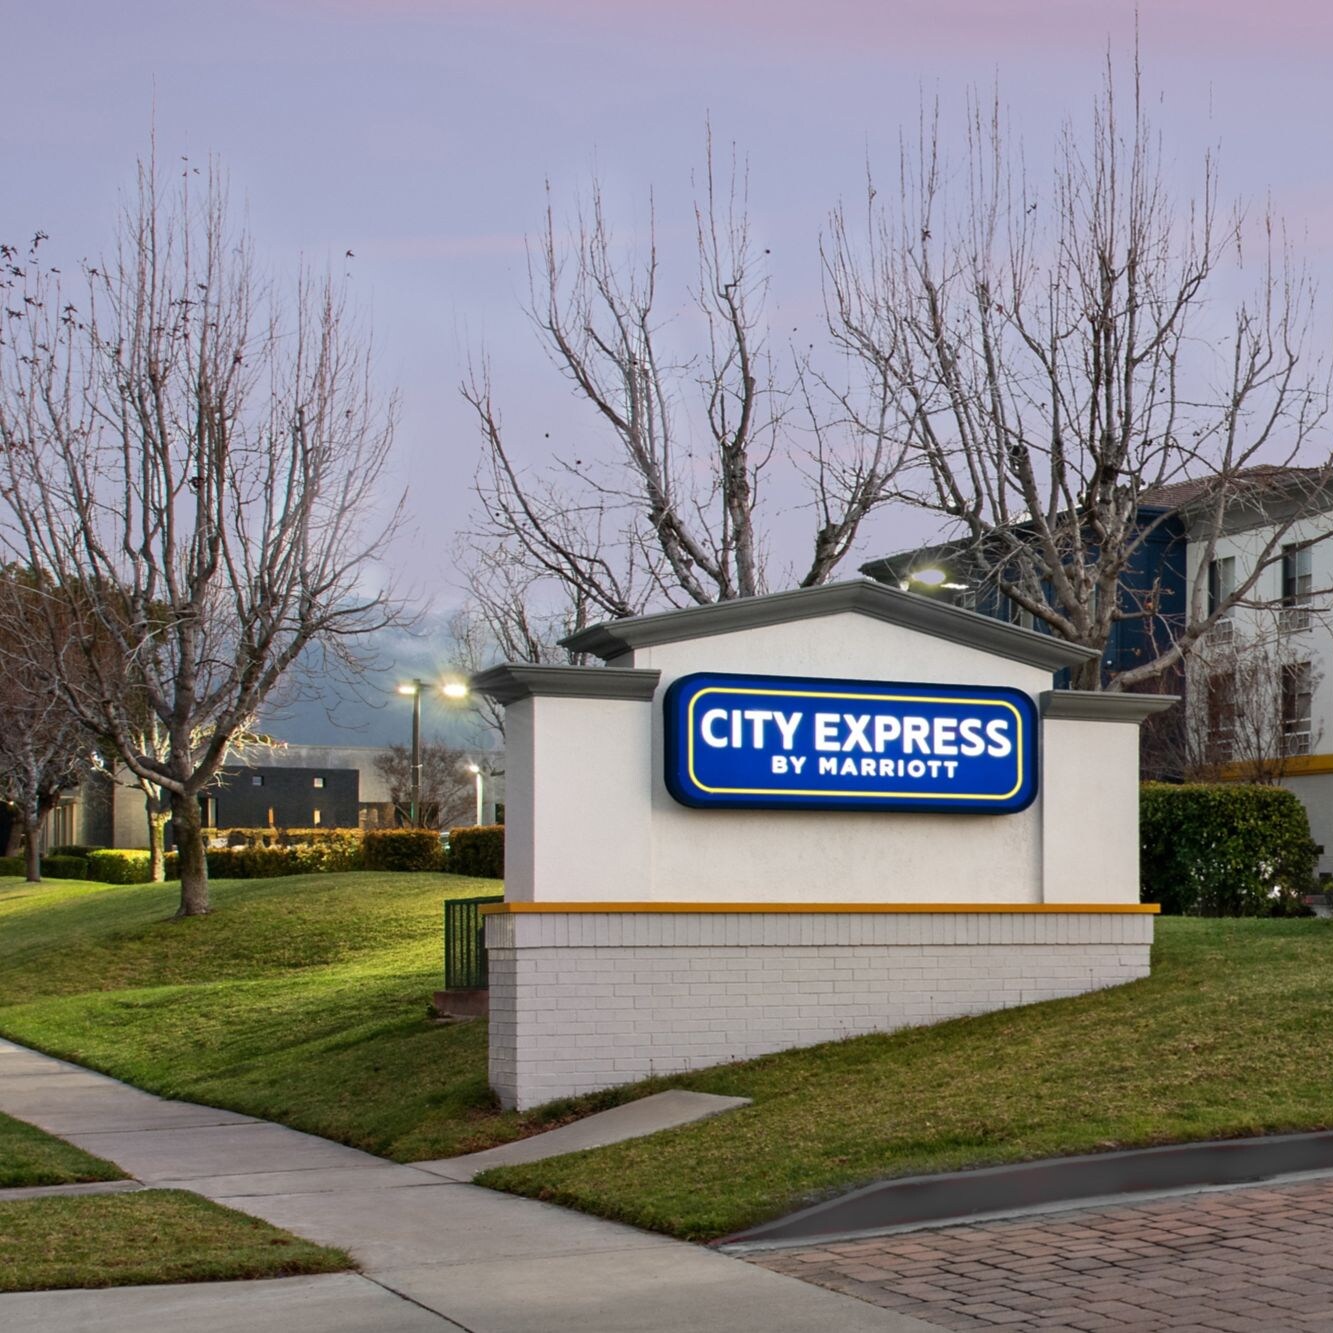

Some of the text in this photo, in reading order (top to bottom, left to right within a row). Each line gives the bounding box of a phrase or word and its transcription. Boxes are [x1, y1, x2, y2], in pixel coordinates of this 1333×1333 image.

[701, 709, 1012, 757] CITY EXPRESS
[772, 756, 958, 778] BY MARRIOTT
